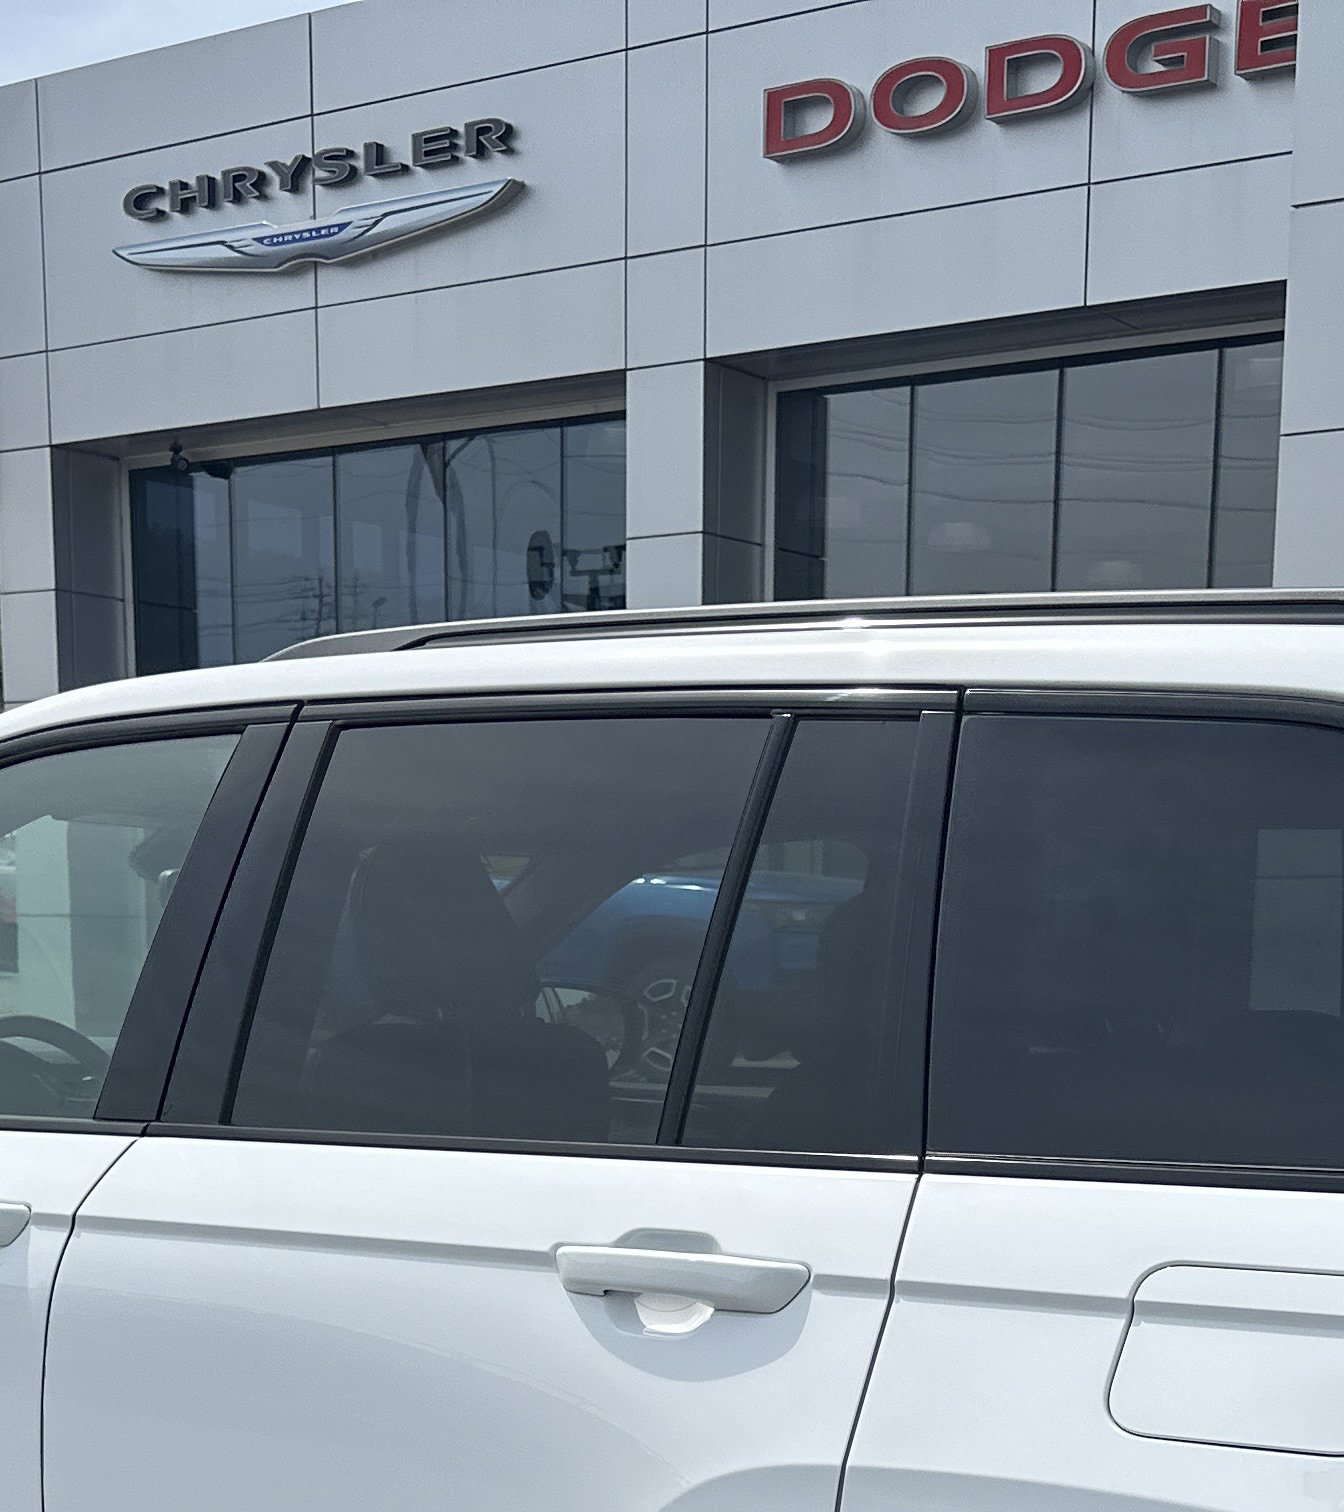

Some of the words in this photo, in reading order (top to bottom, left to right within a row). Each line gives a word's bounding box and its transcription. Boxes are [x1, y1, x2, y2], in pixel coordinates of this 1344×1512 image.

[762, 0, 1298, 163] DODGE
[122, 117, 514, 221] CHRYSLER
[262, 226, 339, 245] CHRYSLER
